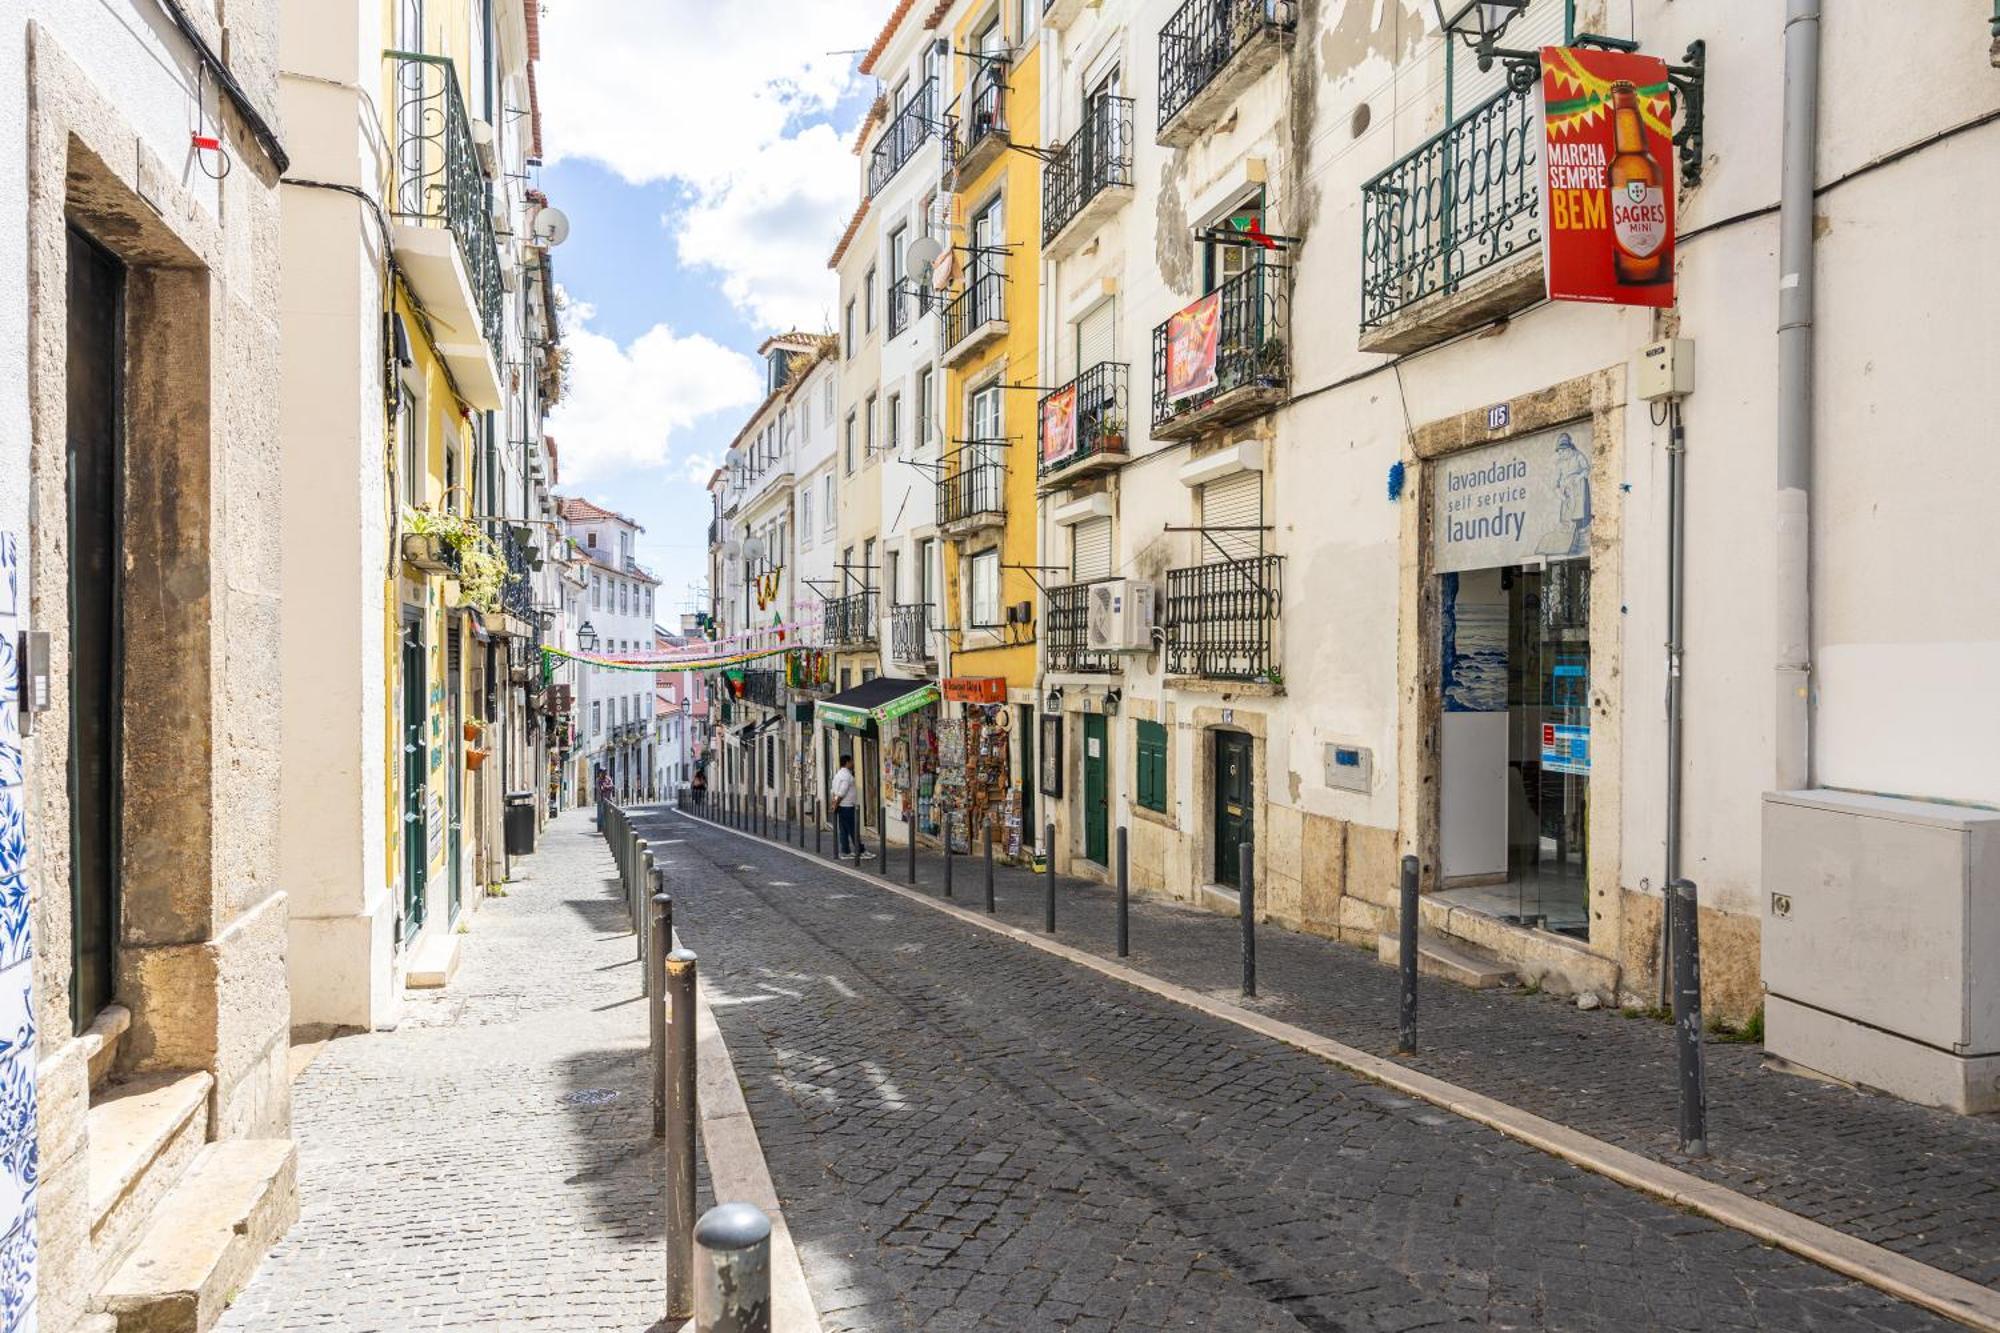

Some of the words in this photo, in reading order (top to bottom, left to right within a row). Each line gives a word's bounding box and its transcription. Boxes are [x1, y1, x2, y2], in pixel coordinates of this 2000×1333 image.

[1547, 143, 1607, 166] MARCHA
[1550, 166, 1606, 189] SEMPRE
[1552, 188, 1607, 230] BEM
[1614, 204, 1665, 225] SAGRES
[1629, 223, 1652, 232] MINI
[1490, 406, 1506, 428] 115
[1447, 457, 1527, 493] lavandaria
[1447, 494, 1472, 513] self
[1477, 486, 1527, 508] service
[1447, 506, 1526, 543] laundry
